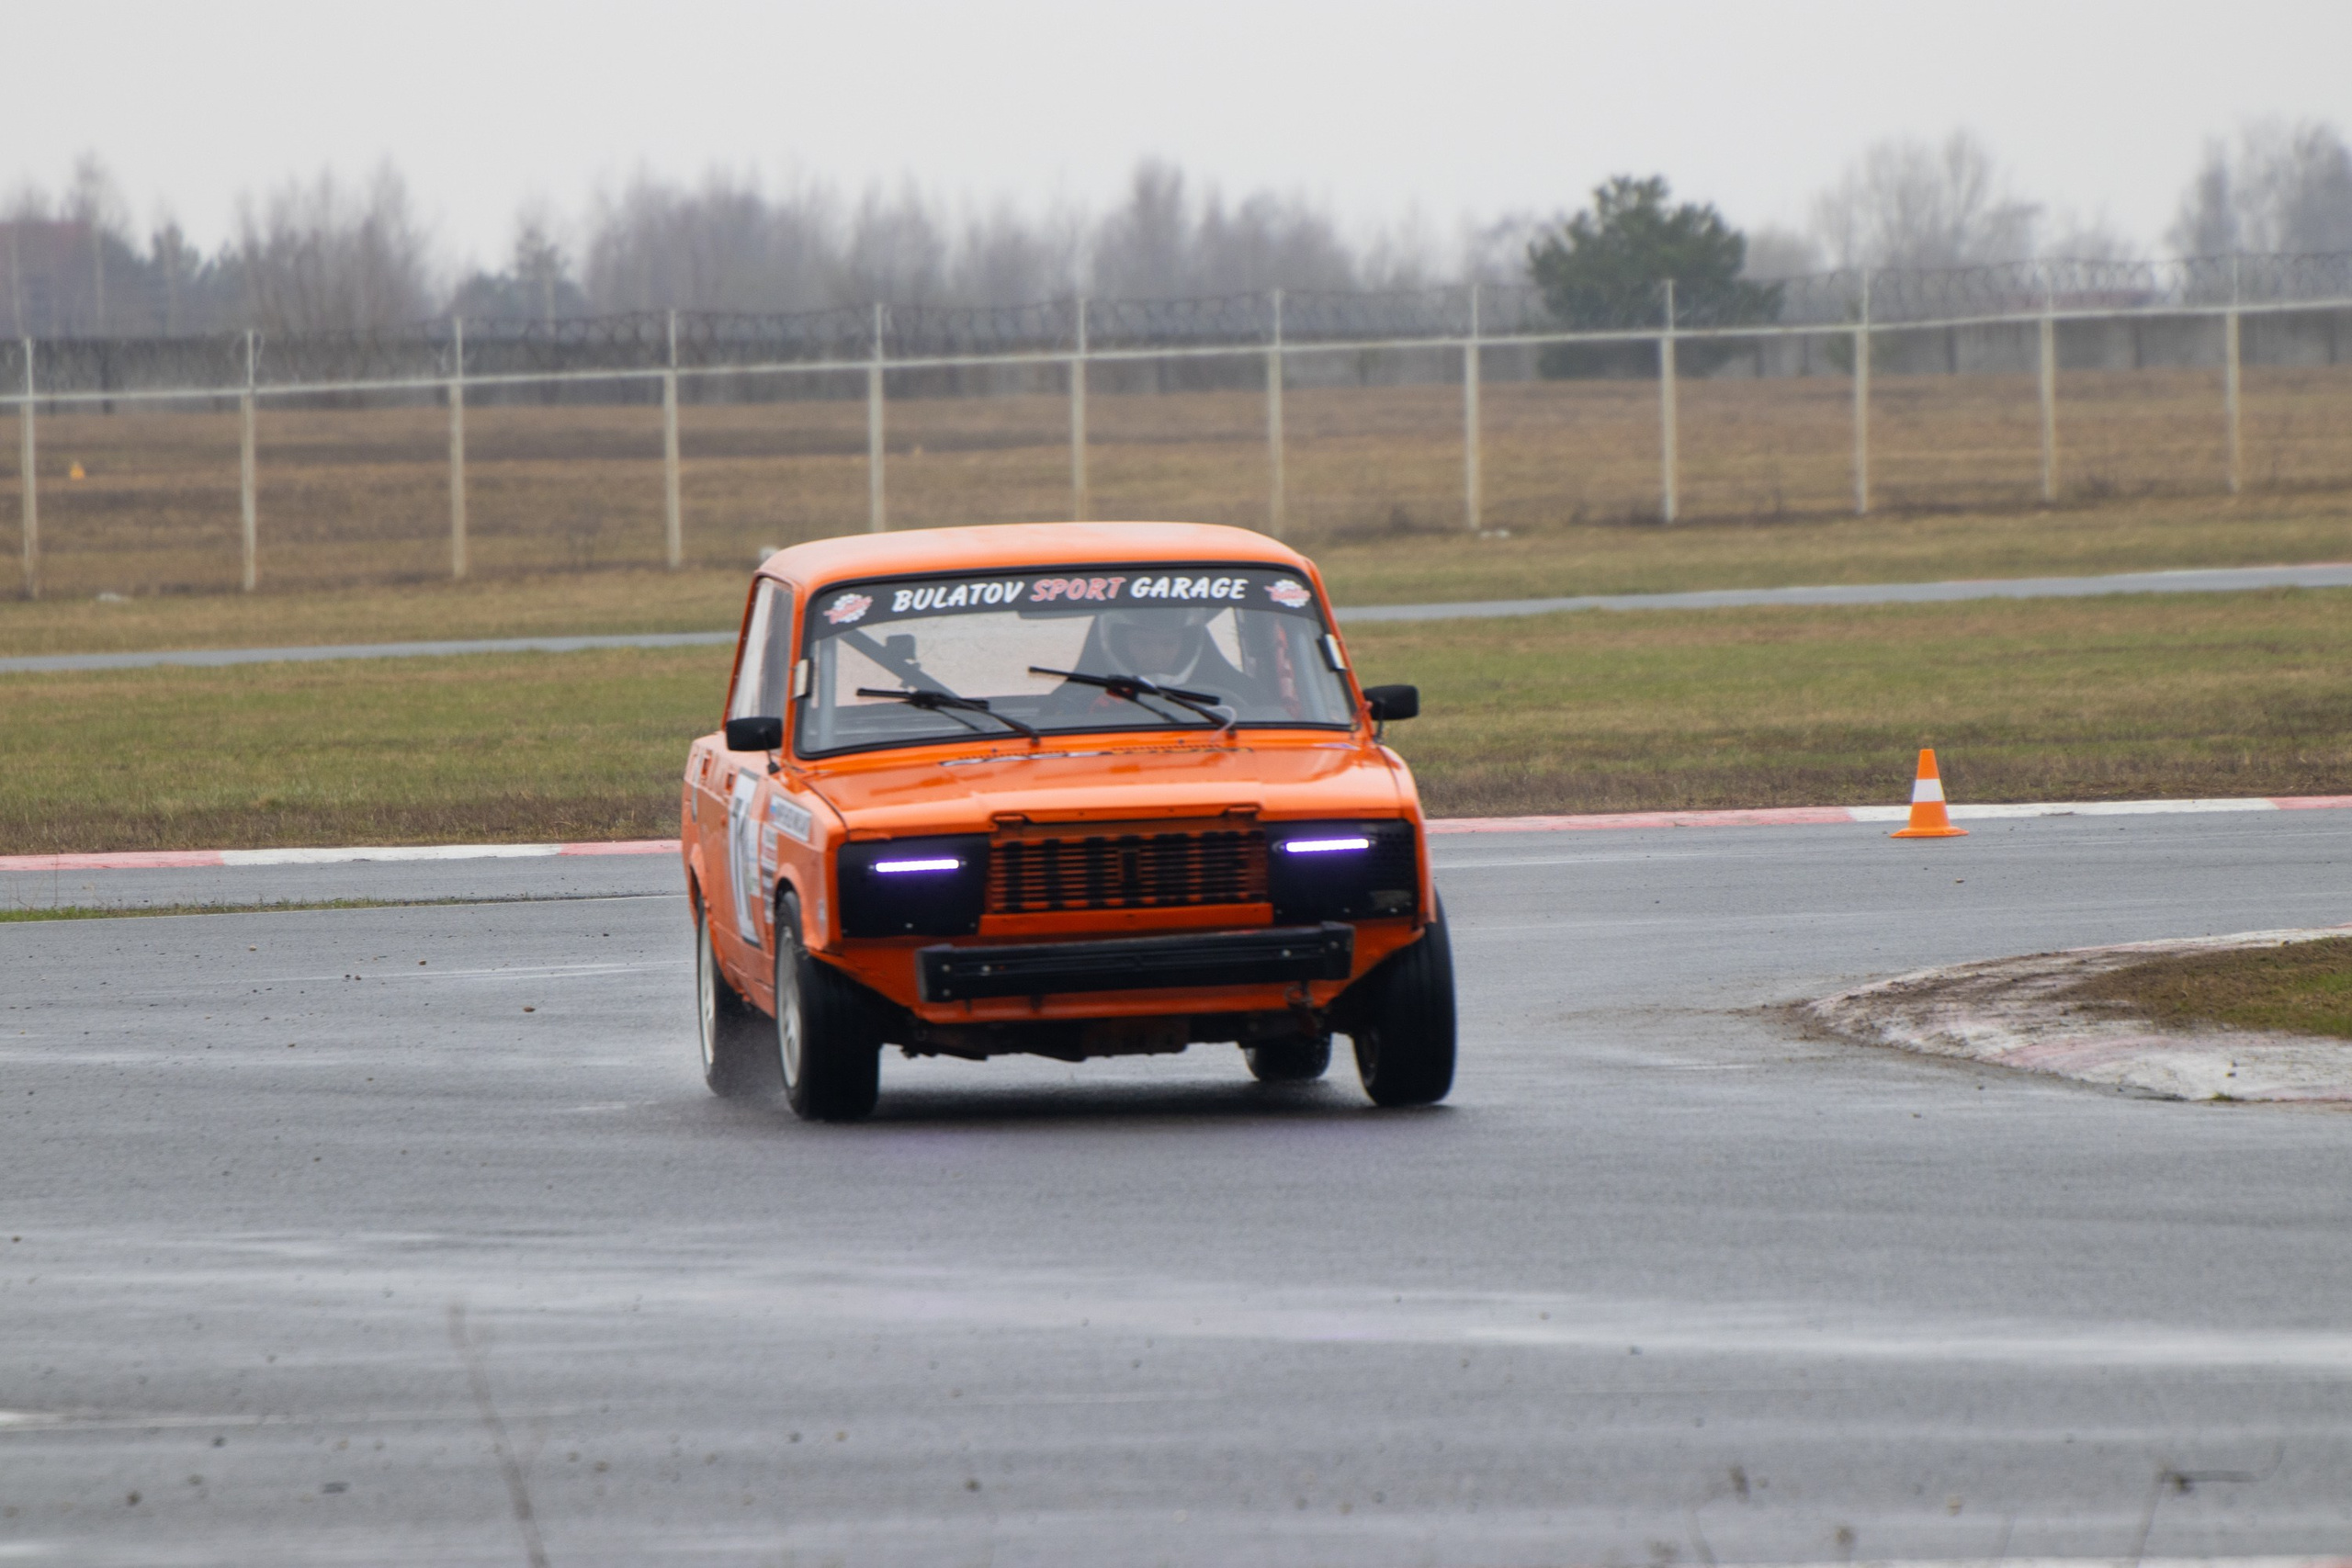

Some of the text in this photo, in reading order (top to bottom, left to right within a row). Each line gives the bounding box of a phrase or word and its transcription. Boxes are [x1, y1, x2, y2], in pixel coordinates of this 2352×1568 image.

[891, 581, 1025, 613] BULATOV
[1030, 577, 1126, 602] SPORT
[1130, 577, 1249, 600] GARAGE
